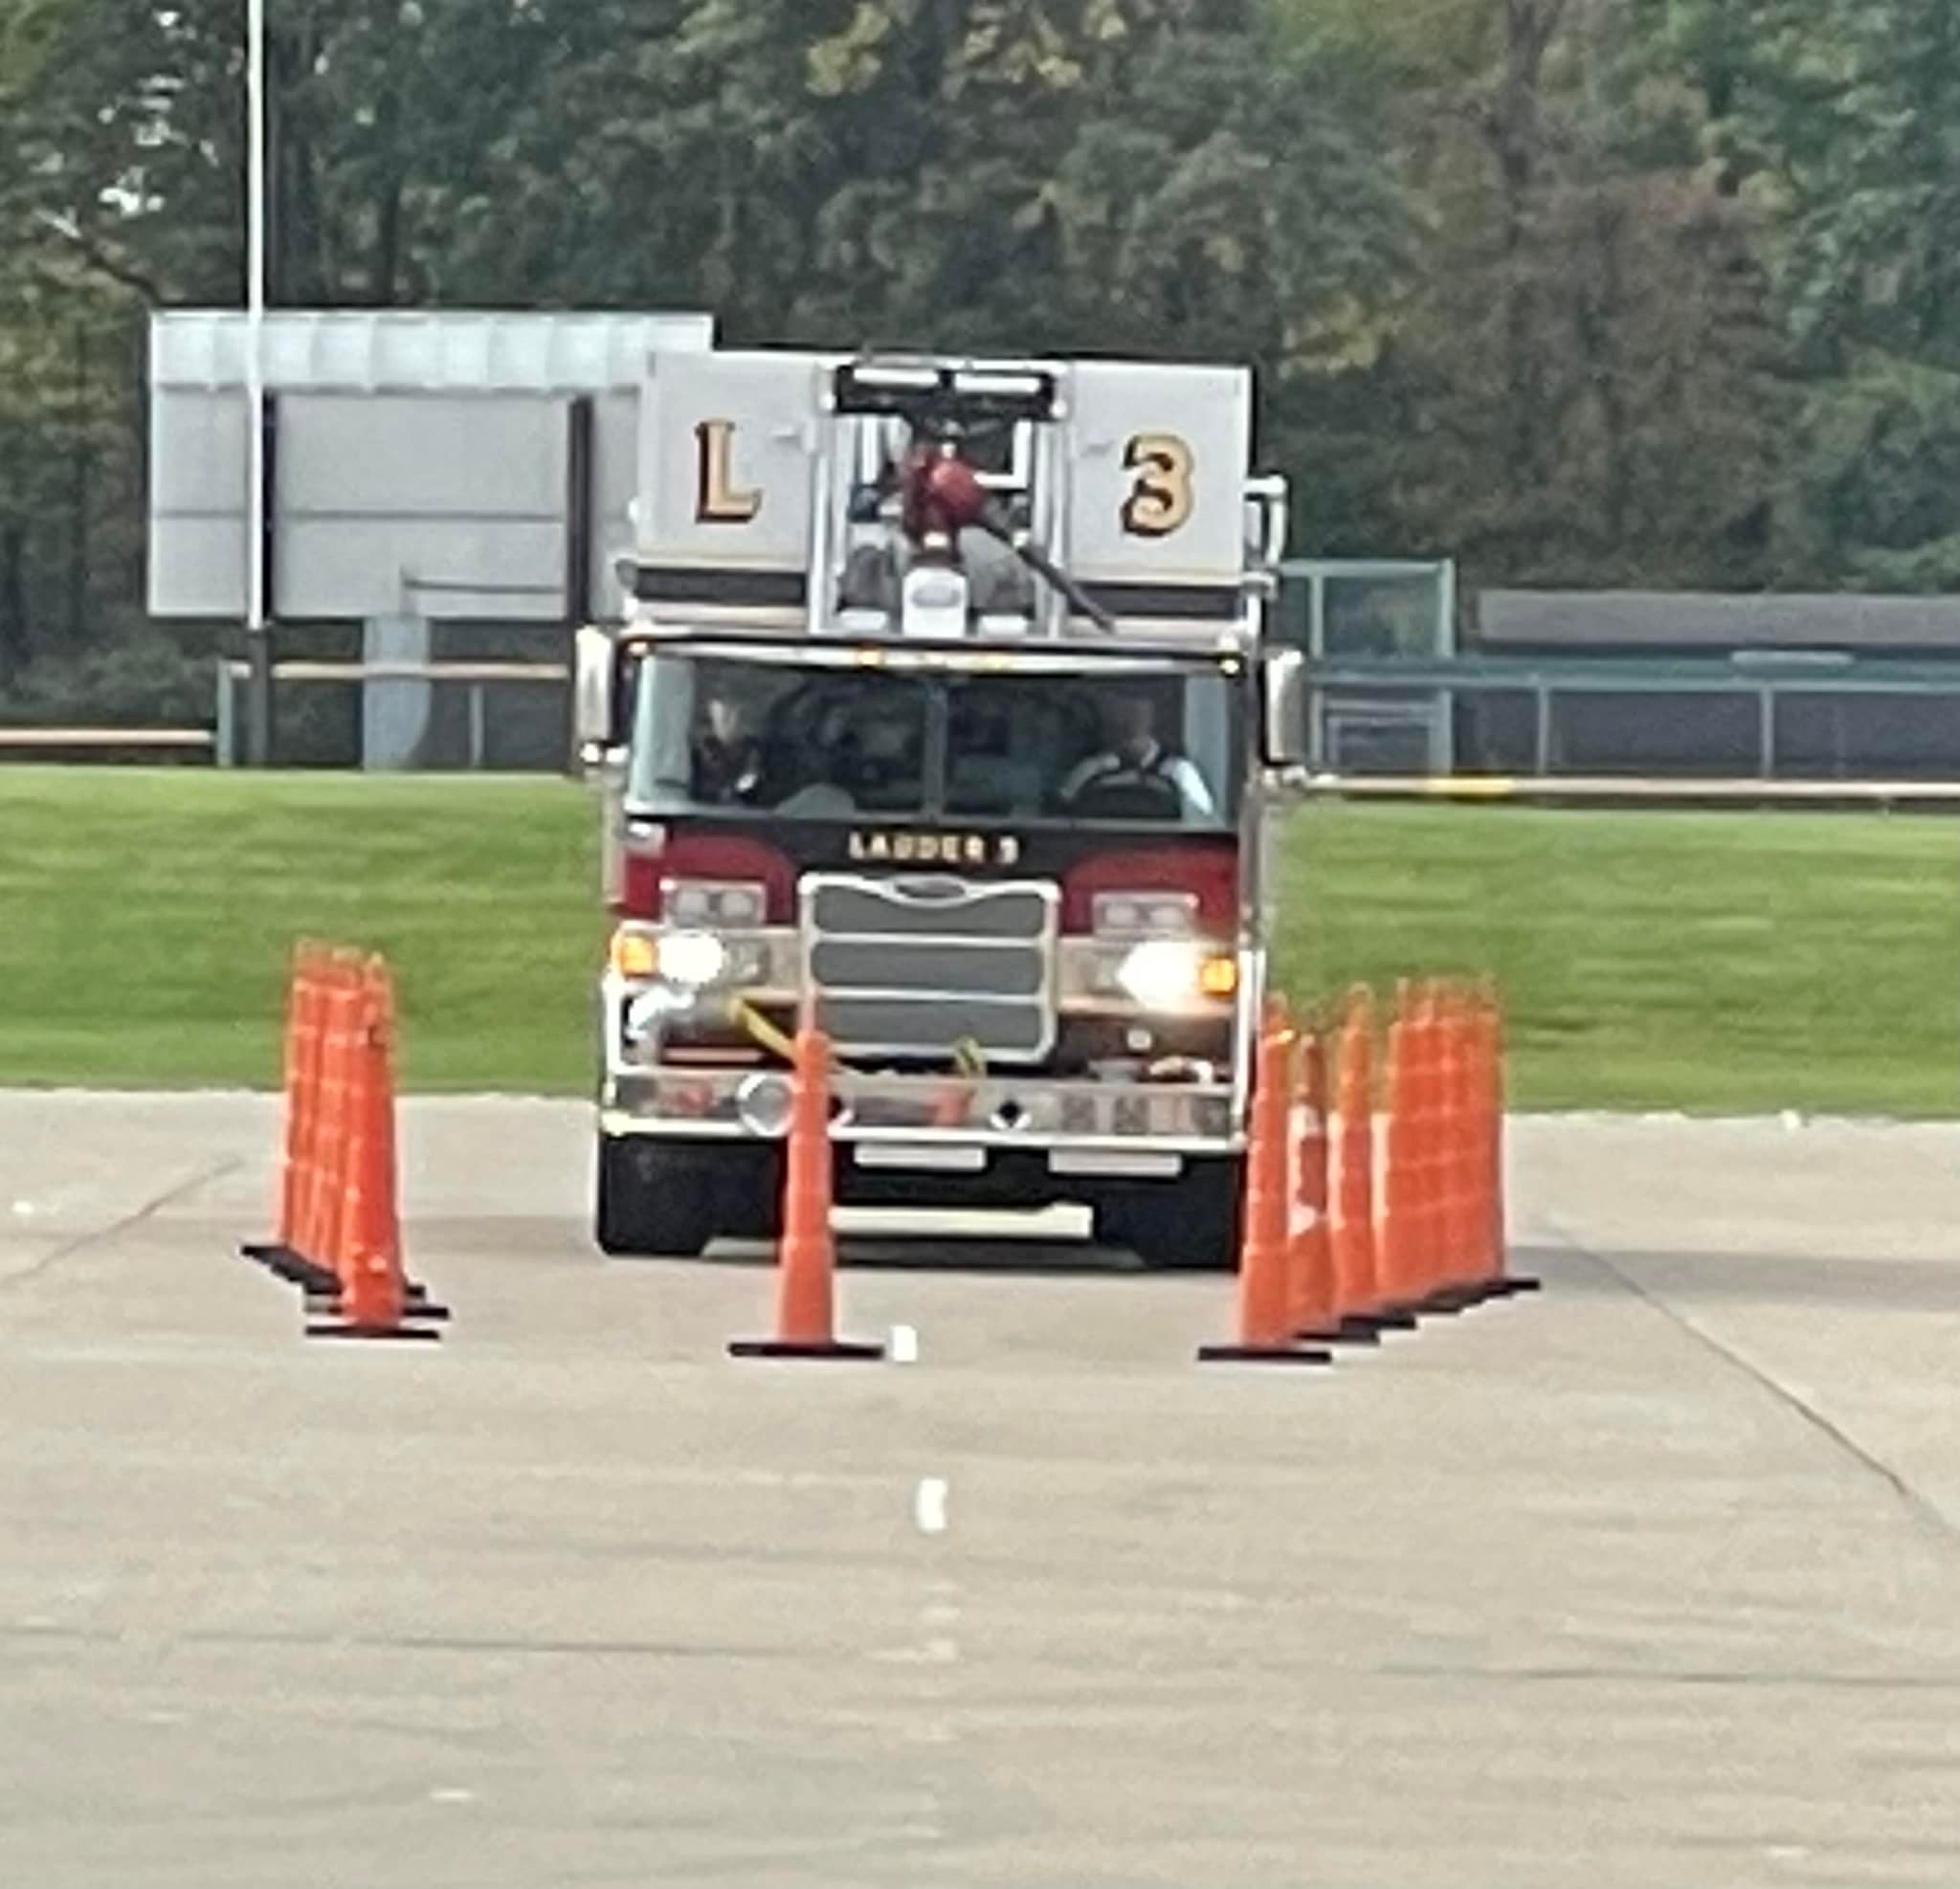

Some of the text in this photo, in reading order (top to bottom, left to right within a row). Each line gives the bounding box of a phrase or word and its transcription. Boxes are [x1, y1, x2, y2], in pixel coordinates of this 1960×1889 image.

[696, 420, 1194, 537] L 3
[849, 832, 985, 863] LADDER
